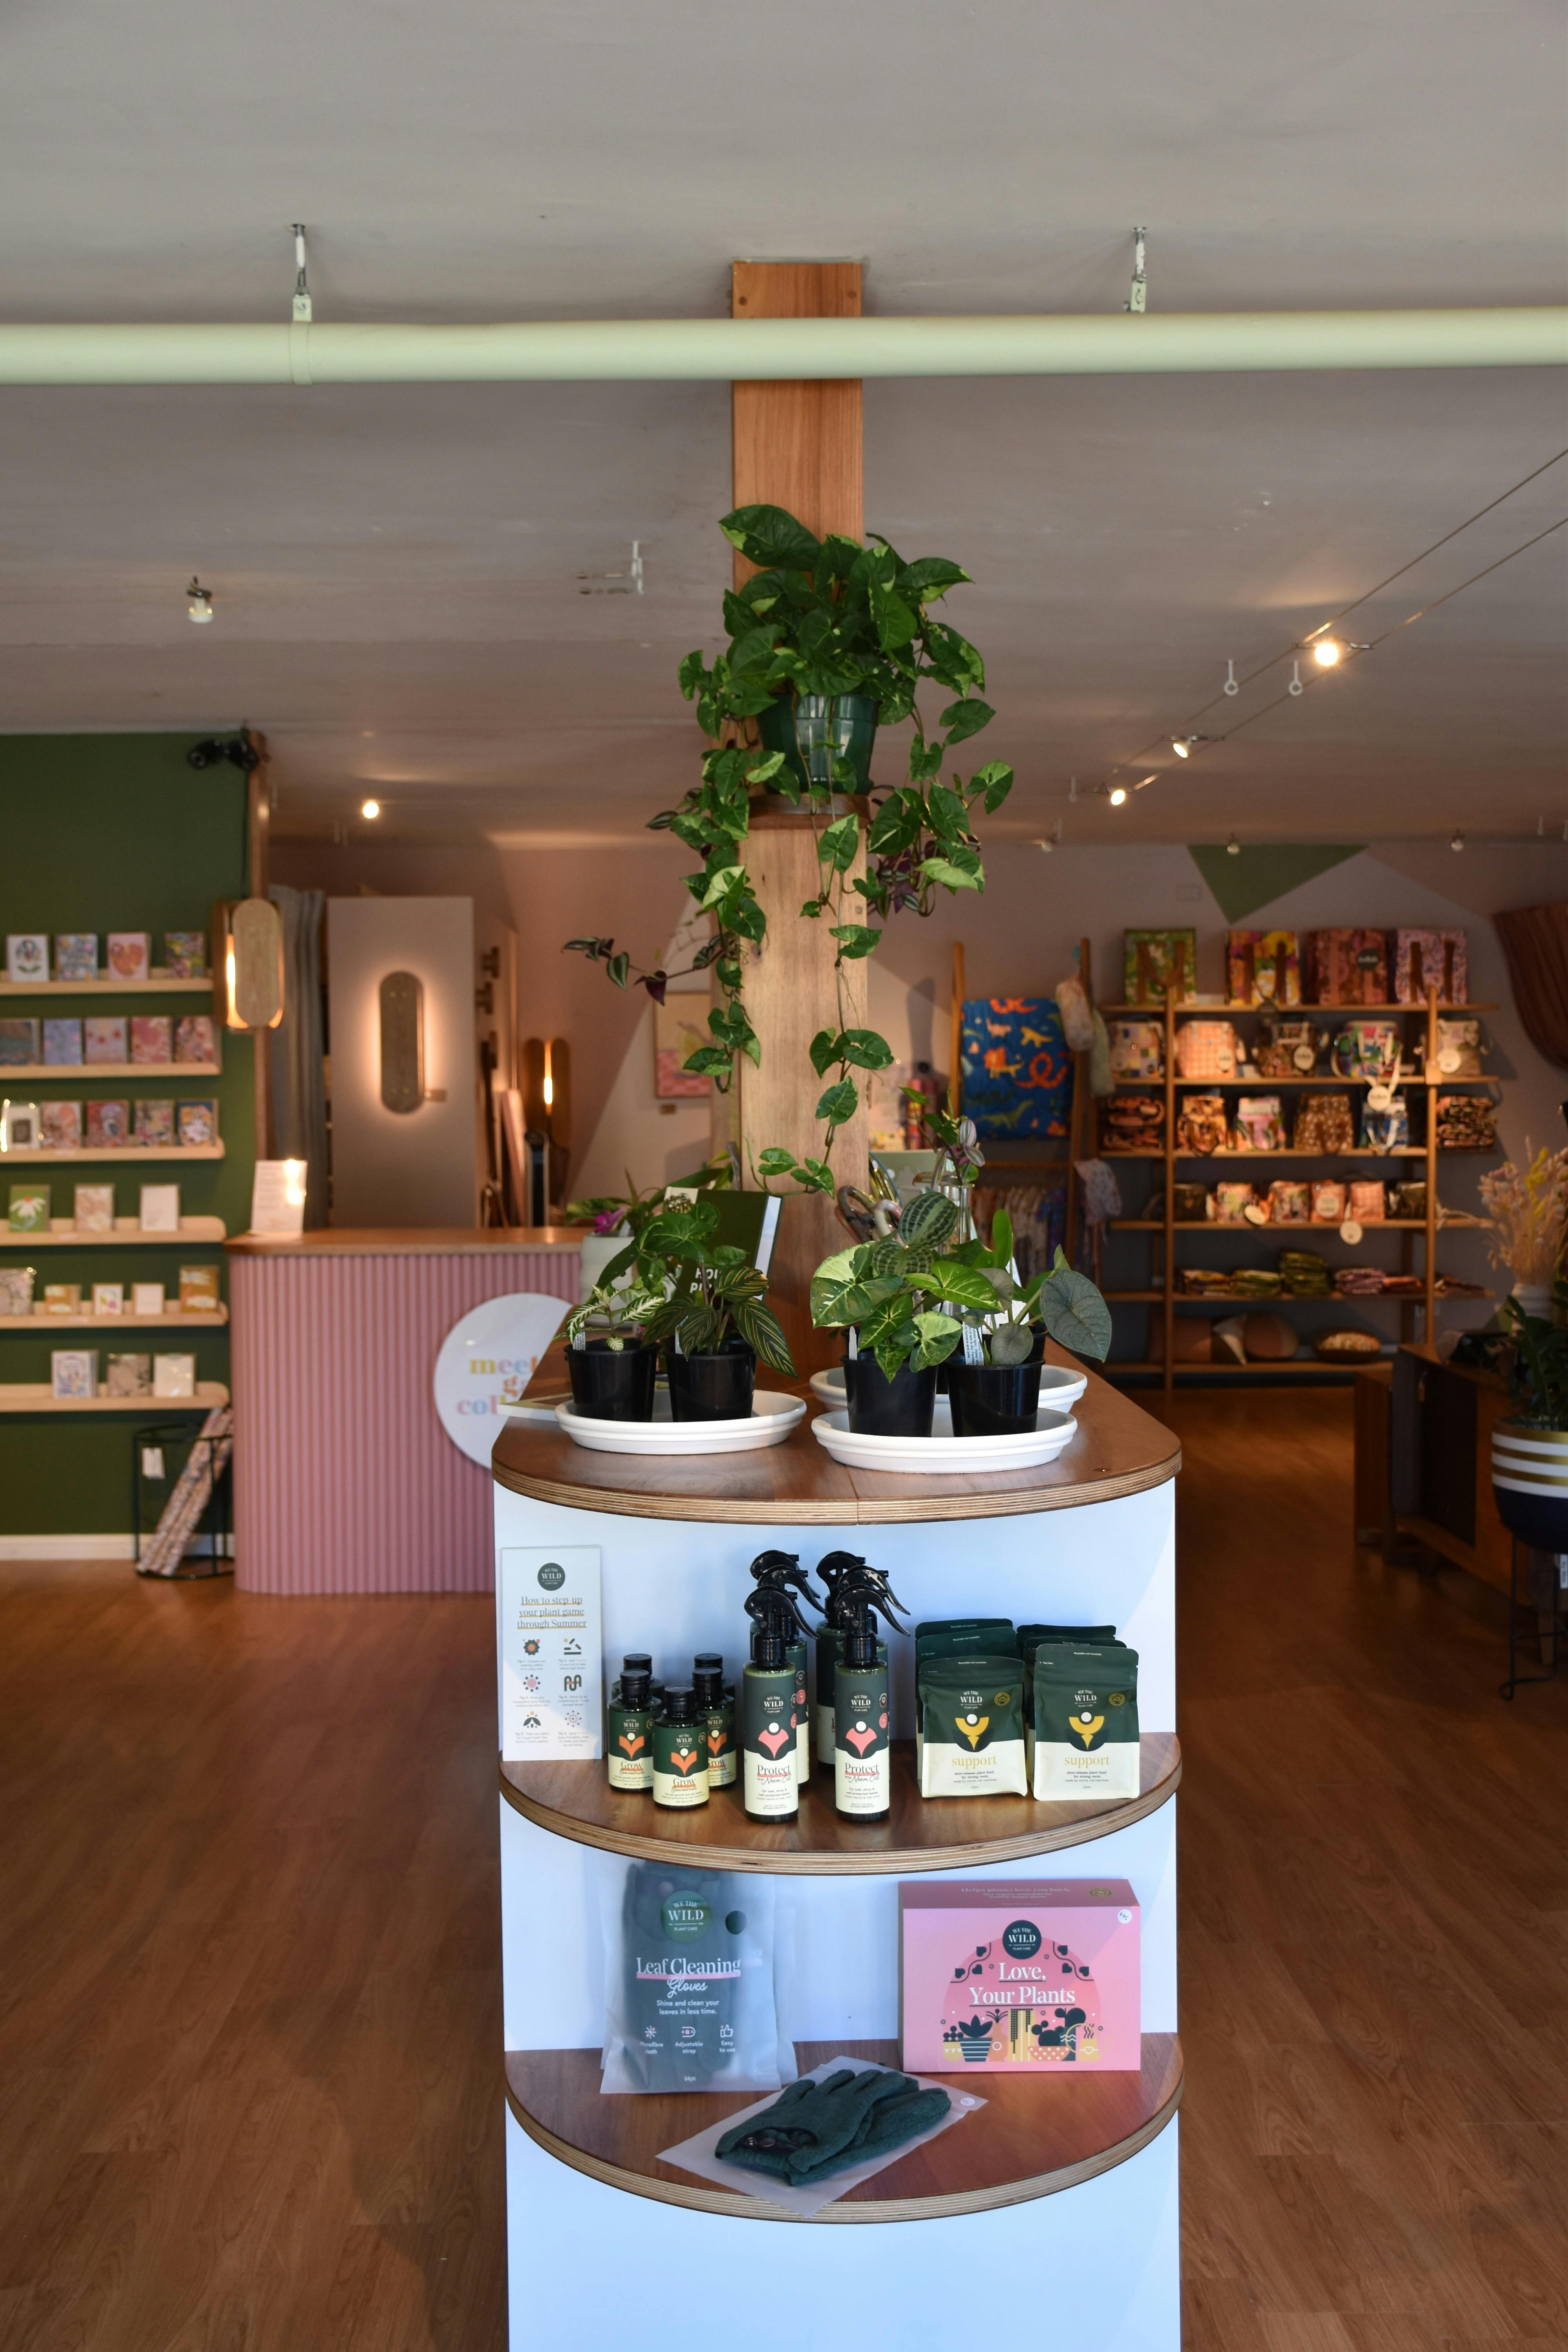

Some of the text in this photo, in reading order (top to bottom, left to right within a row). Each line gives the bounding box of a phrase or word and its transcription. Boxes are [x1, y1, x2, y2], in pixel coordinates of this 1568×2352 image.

[540, 1608, 560, 1617] plant
[517, 1620, 549, 1629] through
[845, 1762, 878, 1774] Protect
[951, 1756, 997, 1769] support
[1064, 1756, 1110, 1768] support
[757, 1765, 790, 1775] Protect
[673, 1777, 696, 1786] Grow
[761, 1773, 791, 1785] Neem Oil
[869, 1772, 880, 1782] Oil
[668, 1910, 704, 1920] WILD
[636, 1957, 741, 1977] Leaf Cleaning
[998, 1962, 1046, 1982] Love,
[667, 1976, 708, 1998] Gloves
[969, 1986, 1075, 2004] Your Plants
